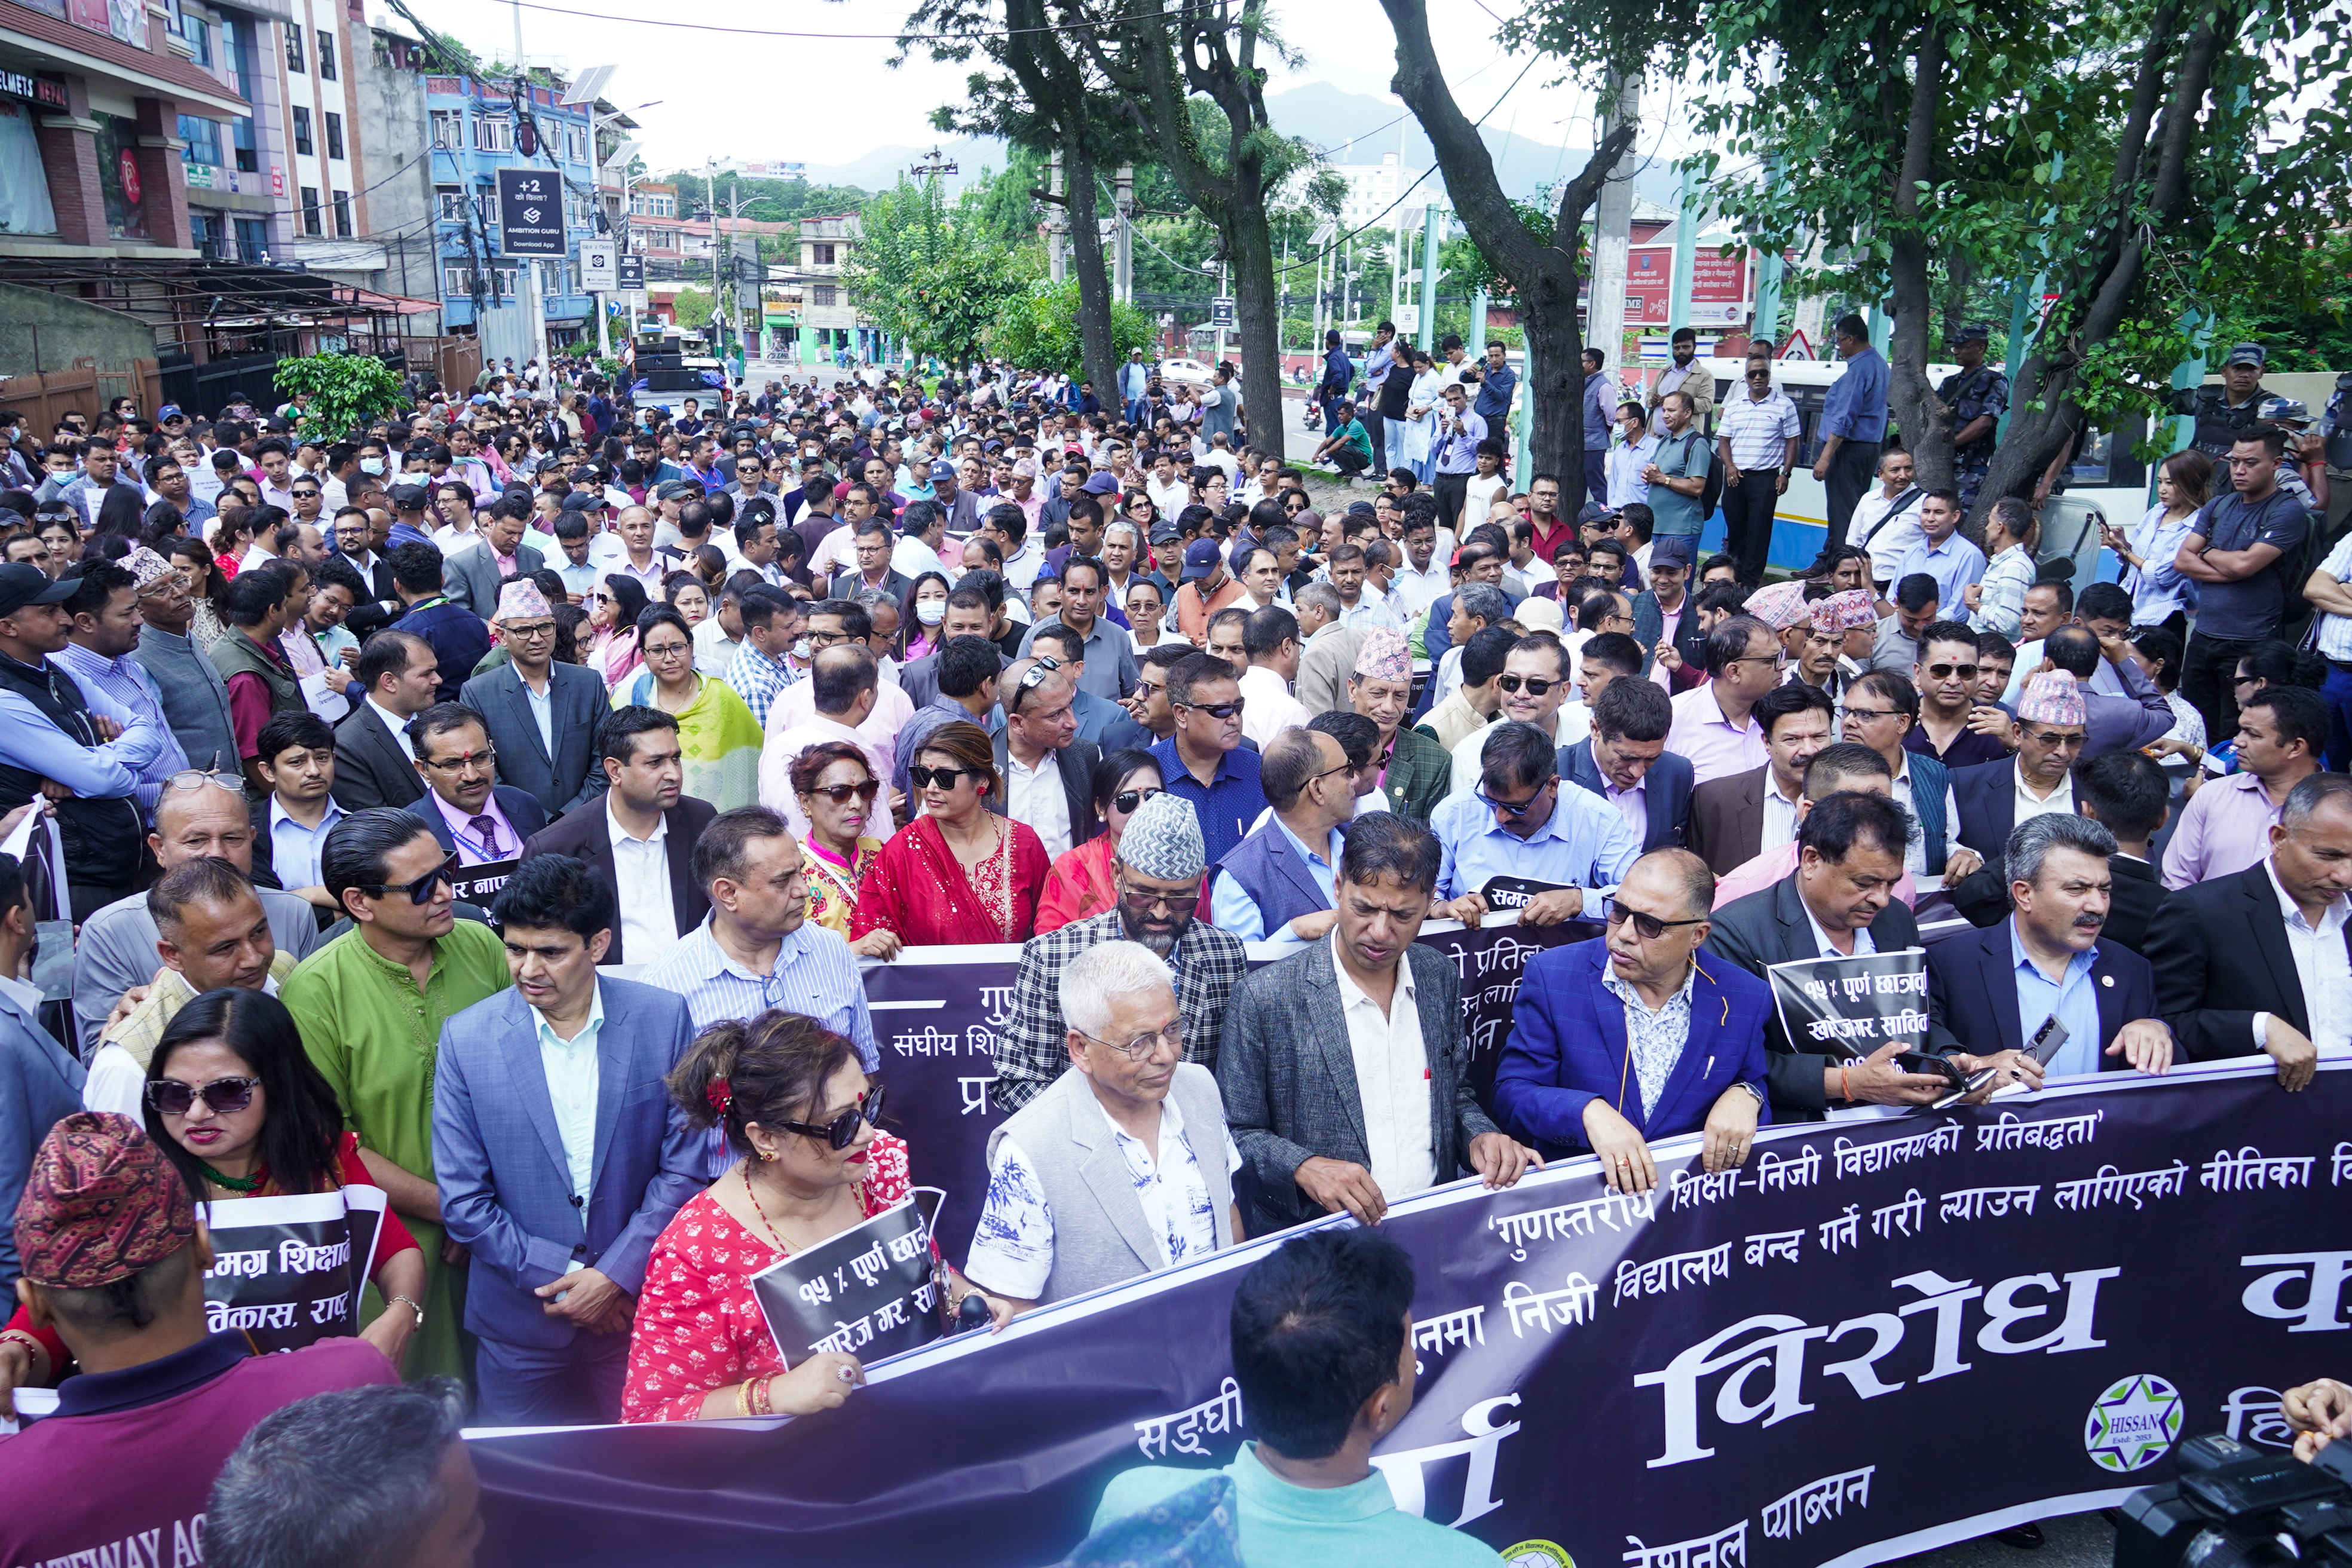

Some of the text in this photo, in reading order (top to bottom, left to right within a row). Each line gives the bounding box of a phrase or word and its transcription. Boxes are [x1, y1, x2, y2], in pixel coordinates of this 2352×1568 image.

[514, 192, 524, 201] को
[519, 179, 540, 192] +2
[445, 820, 493, 861] THE SUNSHINE SCH
[1842, 971, 1870, 1002] पूर्ण
[893, 1027, 958, 1056] संघीय
[1833, 1117, 1964, 1180] विद्यालयको
[1016, 1248, 1034, 1259] BEACH
[1502, 1272, 1600, 1339] निजी
[1613, 1242, 1732, 1308] विद्यालय
[1744, 1229, 1805, 1267] बन्द
[1818, 1203, 1860, 1255] गर्ने
[1871, 1189, 1927, 1239] गरी
[1939, 1185, 2041, 1223] ल्याउन
[2053, 1158, 2189, 1210] लागिएको
[2200, 1146, 2316, 1193] नीतिका
[850, 1240, 889, 1287] पूर्ण
[1634, 1266, 2121, 1469] विरोध
[2110, 1413, 2160, 1435] HISSAN
[2112, 1434, 2152, 1445] Estd: 2053
[1762, 1464, 1876, 1541] प्याब्सन
